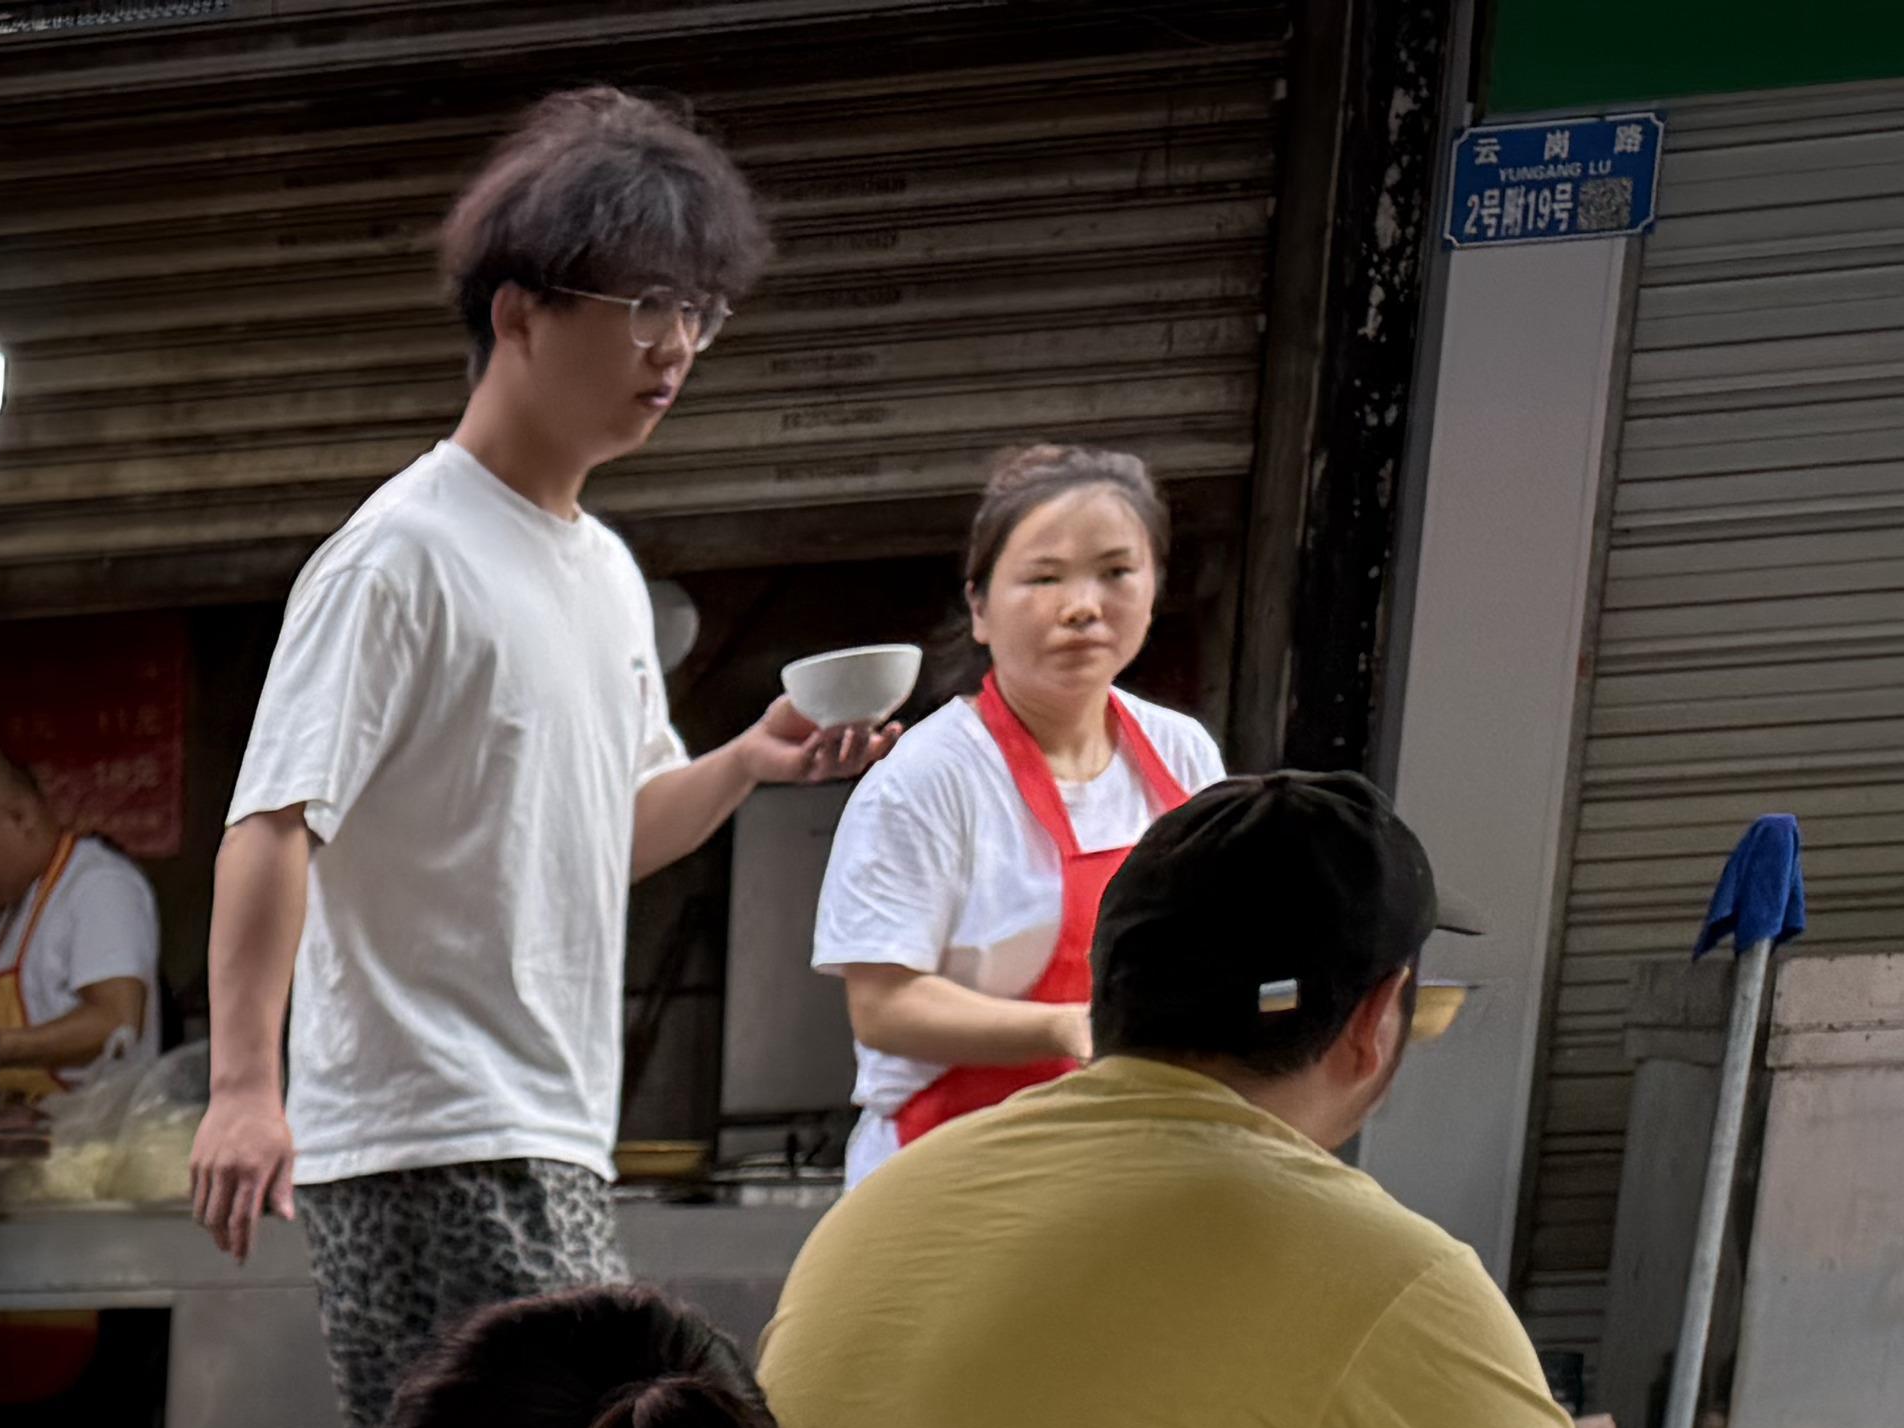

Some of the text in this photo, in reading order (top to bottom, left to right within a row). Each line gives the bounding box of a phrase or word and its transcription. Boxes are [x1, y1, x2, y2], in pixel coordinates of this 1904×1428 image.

[1473, 124, 1643, 166] 云岗路
[1499, 159, 1612, 182] YUNGANG LU
[1464, 182, 1573, 238] 2号附19号
